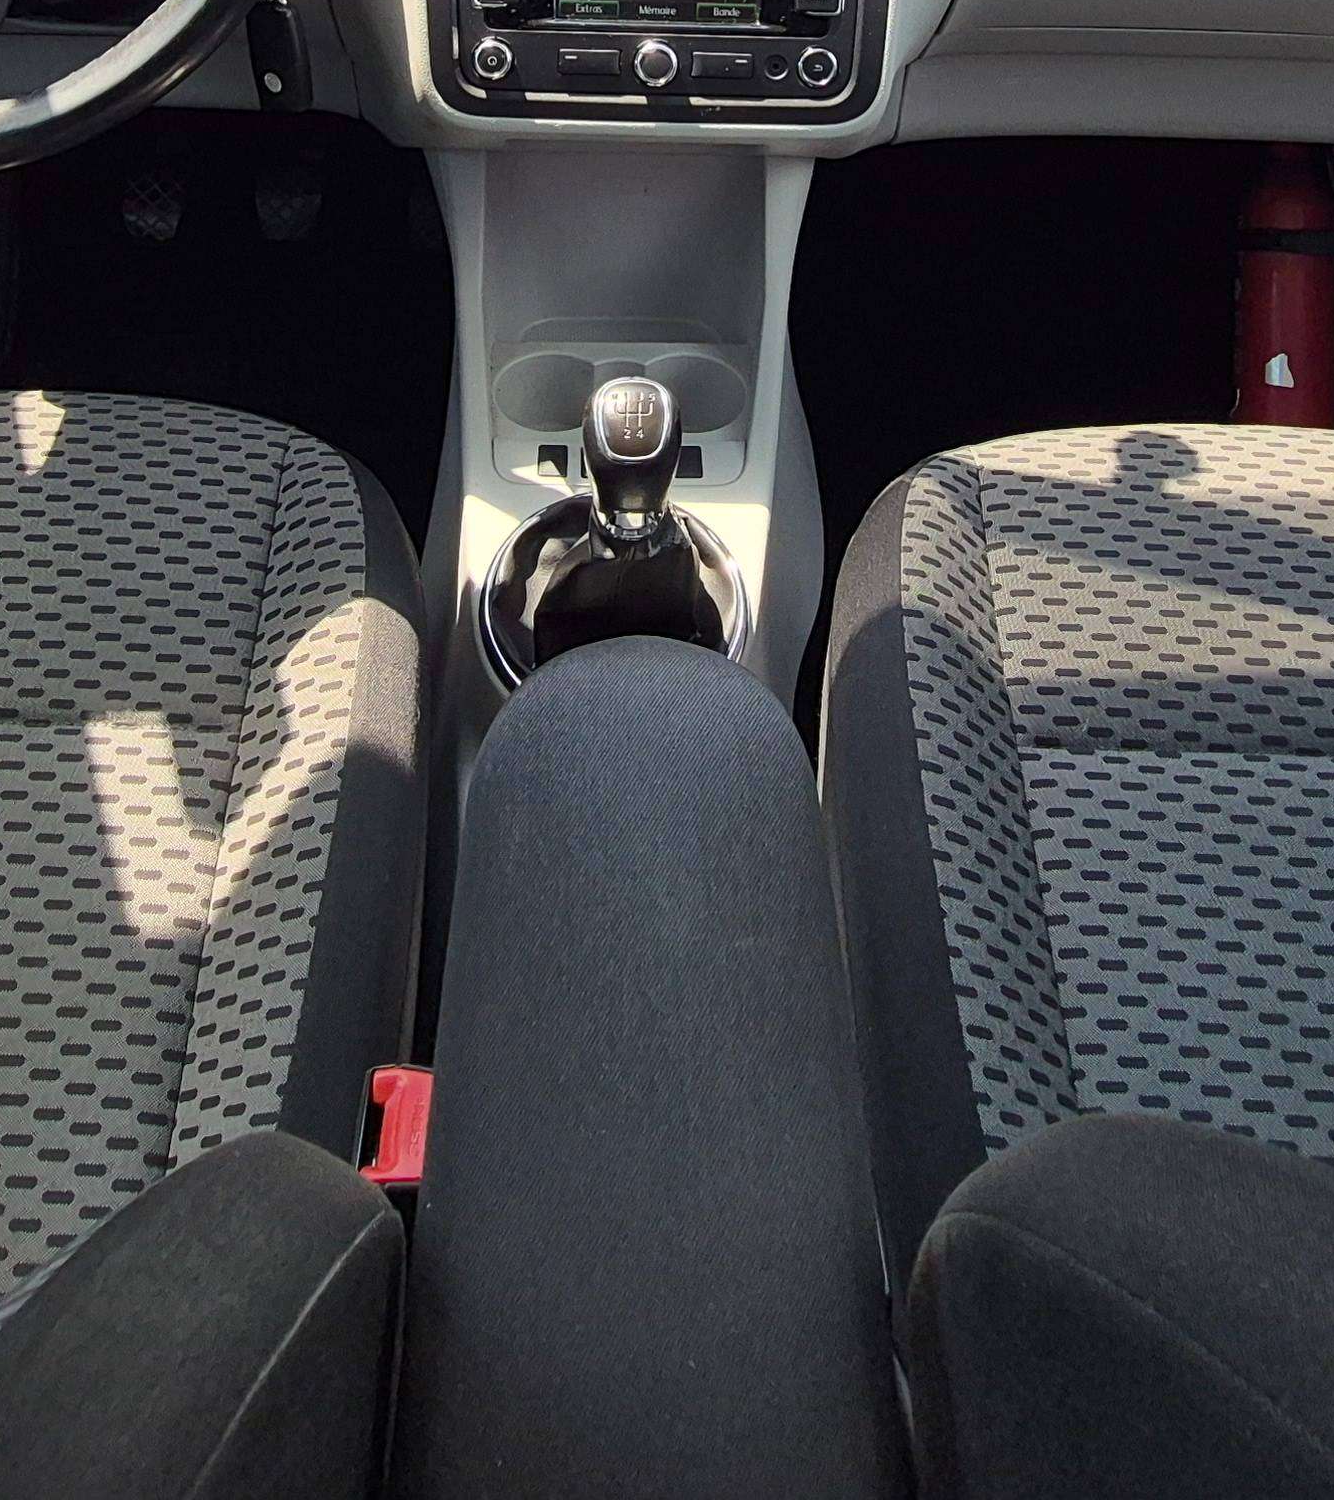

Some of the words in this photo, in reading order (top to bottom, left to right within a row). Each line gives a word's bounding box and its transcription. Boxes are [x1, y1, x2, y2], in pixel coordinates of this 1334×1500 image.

[575, 4, 603, 14] Extras
[639, 5, 677, 16] Mémoire
[713, 7, 741, 17] Bande
[623, 428, 631, 438] 2
[636, 428, 644, 439] 4
